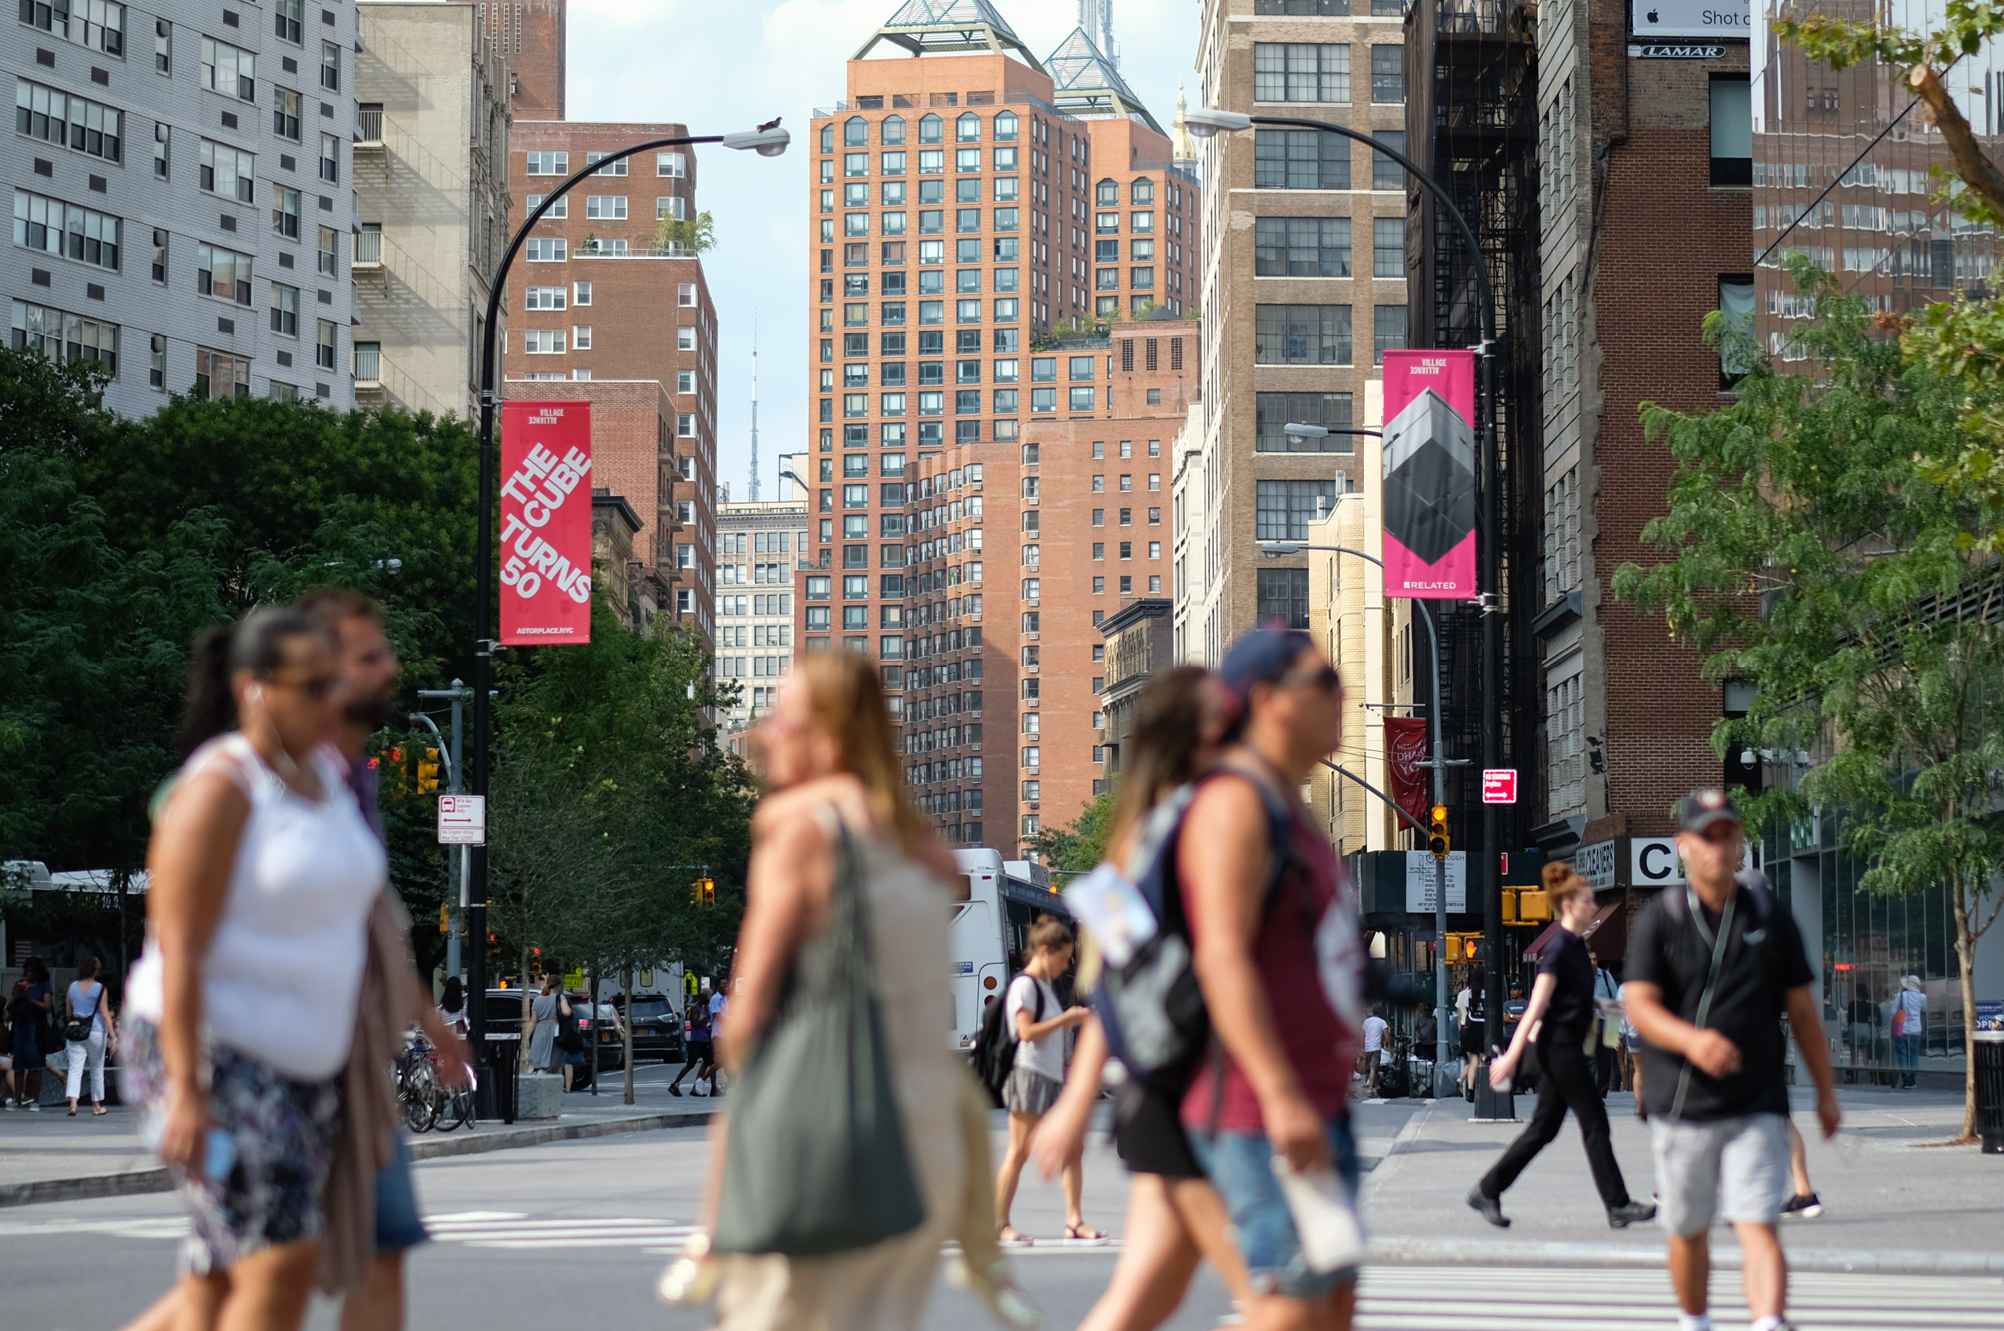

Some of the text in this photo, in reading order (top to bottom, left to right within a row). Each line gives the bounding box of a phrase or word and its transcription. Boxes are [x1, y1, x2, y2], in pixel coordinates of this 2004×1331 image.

[1702, 10, 1739, 26] Shot
[1648, 47, 1718, 56] LAMAR
[1421, 358, 1447, 366] VILLAGE
[1410, 366, 1439, 375] ALLIANCE
[540, 408, 564, 417] VILLAGE
[528, 416, 558, 425] ALLIANCE
[501, 442, 559, 505] THE
[523, 445, 592, 528] CUBE
[500, 513, 592, 604] TURNS
[500, 555, 542, 599] 50
[1410, 581, 1457, 590] RELATED
[516, 626, 574, 635] ASTORPLACE.NYC
[1585, 842, 1614, 877] CLEANERS
